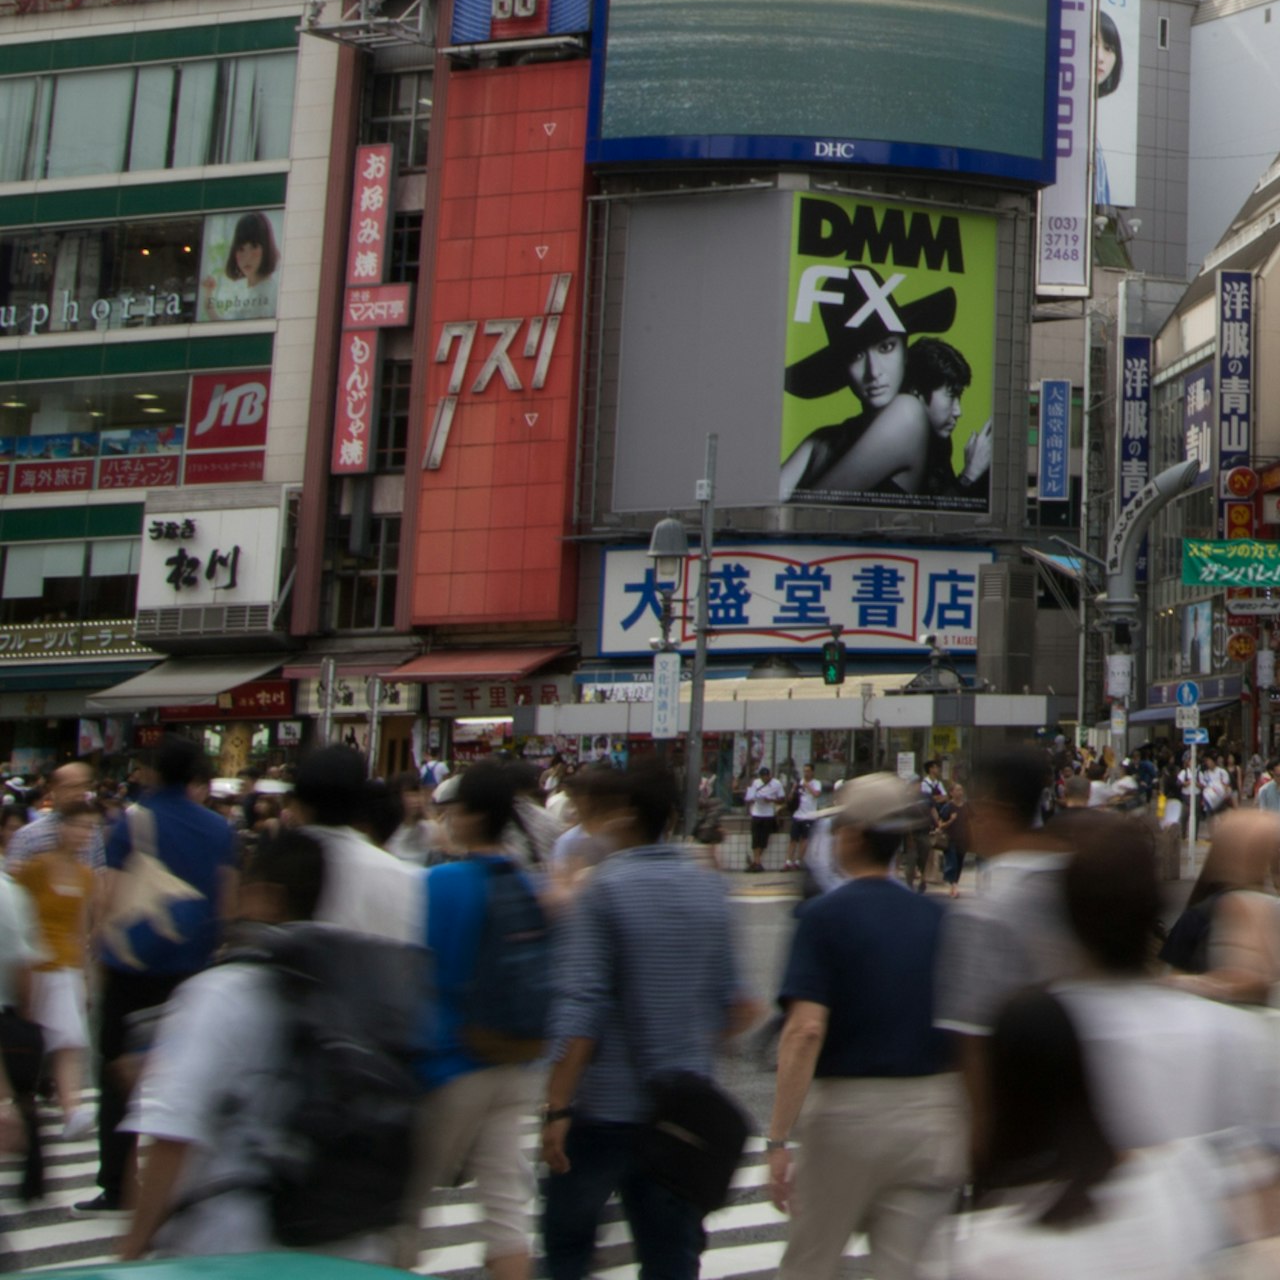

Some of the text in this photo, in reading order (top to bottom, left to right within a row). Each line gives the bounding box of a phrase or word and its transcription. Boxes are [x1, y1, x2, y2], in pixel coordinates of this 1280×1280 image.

[814, 140, 855, 159] DHC
[353, 153, 386, 277] お好み焼
[797, 196, 965, 274] DMM
[1044, 233, 1079, 247] 3719
[1047, 216, 1078, 232] (03)
[1044, 247, 1079, 262] 2468
[793, 264, 907, 334] FX
[421, 272, 573, 471] クスリ
[1219, 281, 1251, 453] 洋服の青山
[195, 381, 268, 436] JTB
[339, 336, 370, 466] もんじゃ焼
[1121, 357, 1149, 500] 洋服の青
[19, 465, 89, 488] 海外旅行
[101, 471, 175, 488] ウエディング
[106, 458, 173, 473] ハネムーン
[620, 562, 976, 632] 大盛堂書店
